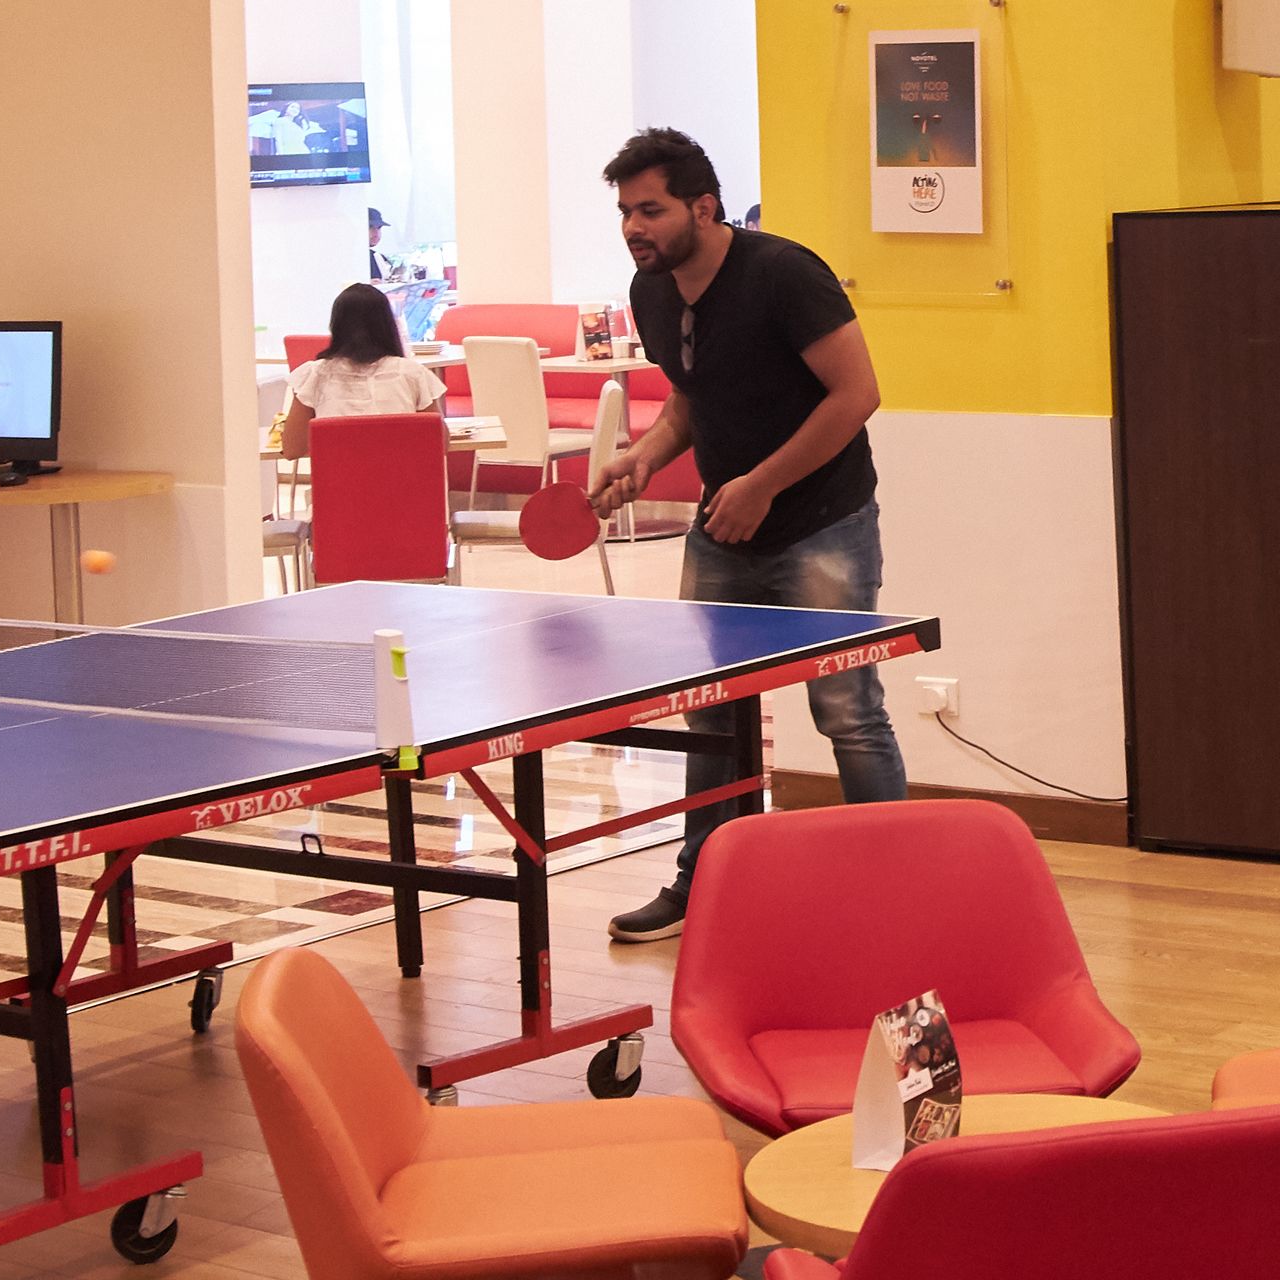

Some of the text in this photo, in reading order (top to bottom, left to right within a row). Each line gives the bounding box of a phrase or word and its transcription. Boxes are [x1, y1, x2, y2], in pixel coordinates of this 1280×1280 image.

[901, 81, 949, 91] LOVE FOOD
[901, 92, 949, 102] NOT WASTE
[913, 188, 937, 199] HERE
[834, 643, 891, 671] VELOX
[667, 682, 729, 712] T.T.F.I.
[488, 732, 524, 760] KING
[218, 785, 306, 823] VELOX
[0, 832, 91, 871] T.T.F.I.
